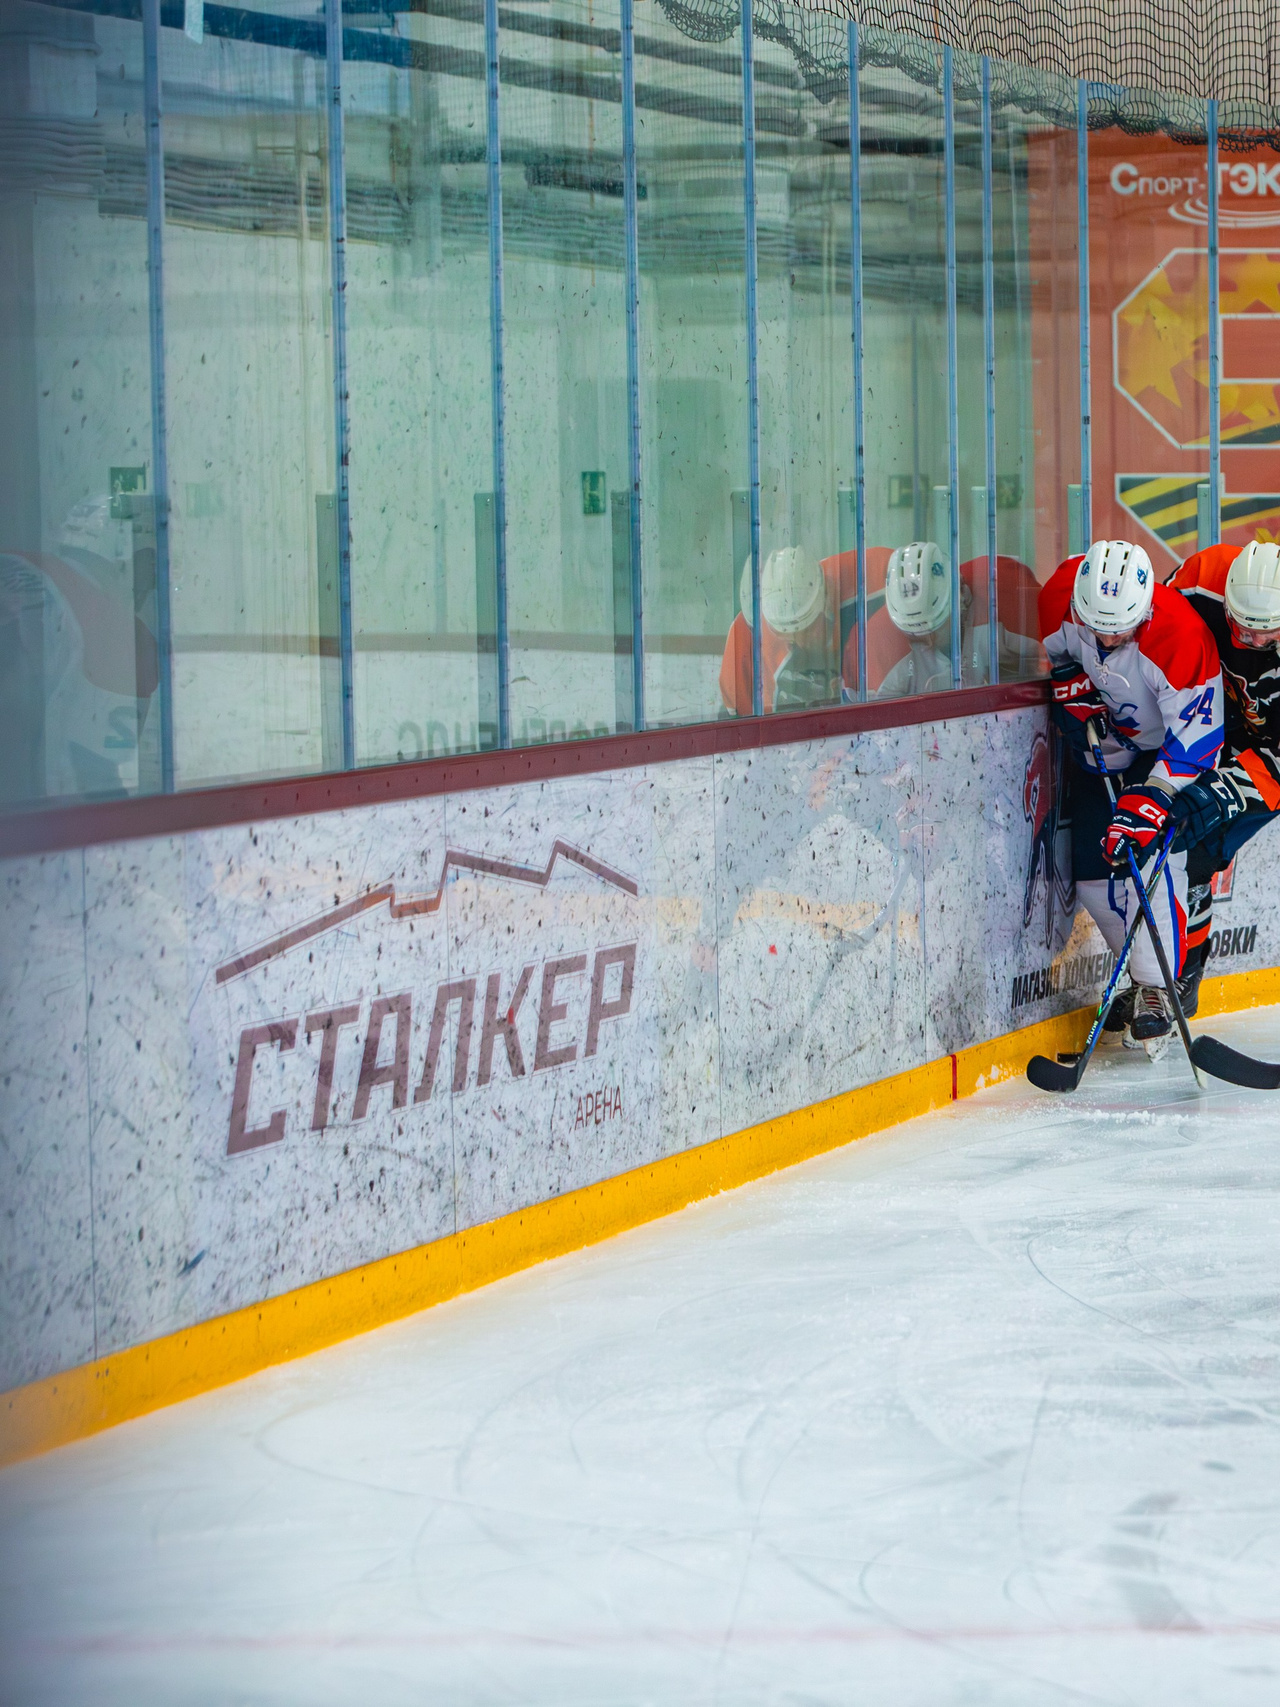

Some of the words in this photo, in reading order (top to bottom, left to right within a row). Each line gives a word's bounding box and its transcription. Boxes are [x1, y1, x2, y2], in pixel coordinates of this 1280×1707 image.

[1178, 687, 1215, 729] 44
[227, 942, 638, 1156] СТАЛКЕР
[574, 1085, 622, 1131] АРЕНА
